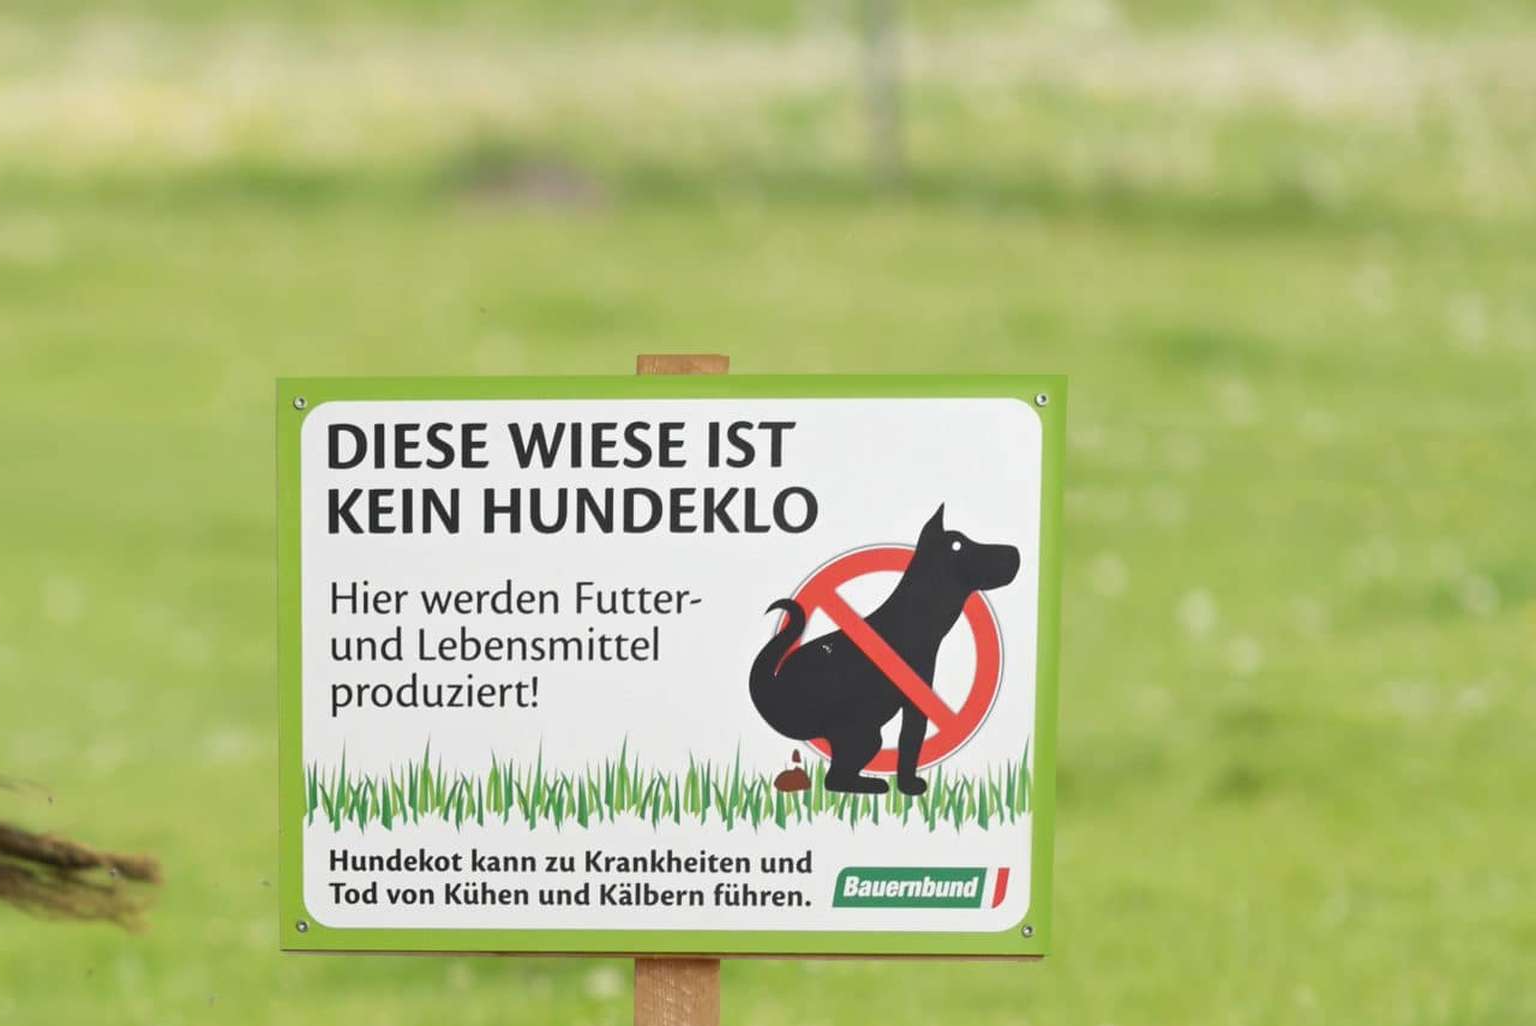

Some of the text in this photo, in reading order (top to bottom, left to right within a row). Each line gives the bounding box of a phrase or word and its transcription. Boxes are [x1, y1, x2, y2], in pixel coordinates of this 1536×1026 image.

[327, 420, 797, 470] DIESE WIESE IST
[328, 486, 819, 535] KEIN HUNDEKLO
[331, 579, 702, 615] Hier werden Futter-
[331, 625, 659, 662] und Lebensmittel
[331, 672, 538, 718] produziert!
[329, 847, 813, 874] Hundekot kann zu Krankheiten und
[328, 880, 812, 907] Tod von Kühen und Kälbern führen.
[842, 875, 980, 898] Bauernbund
